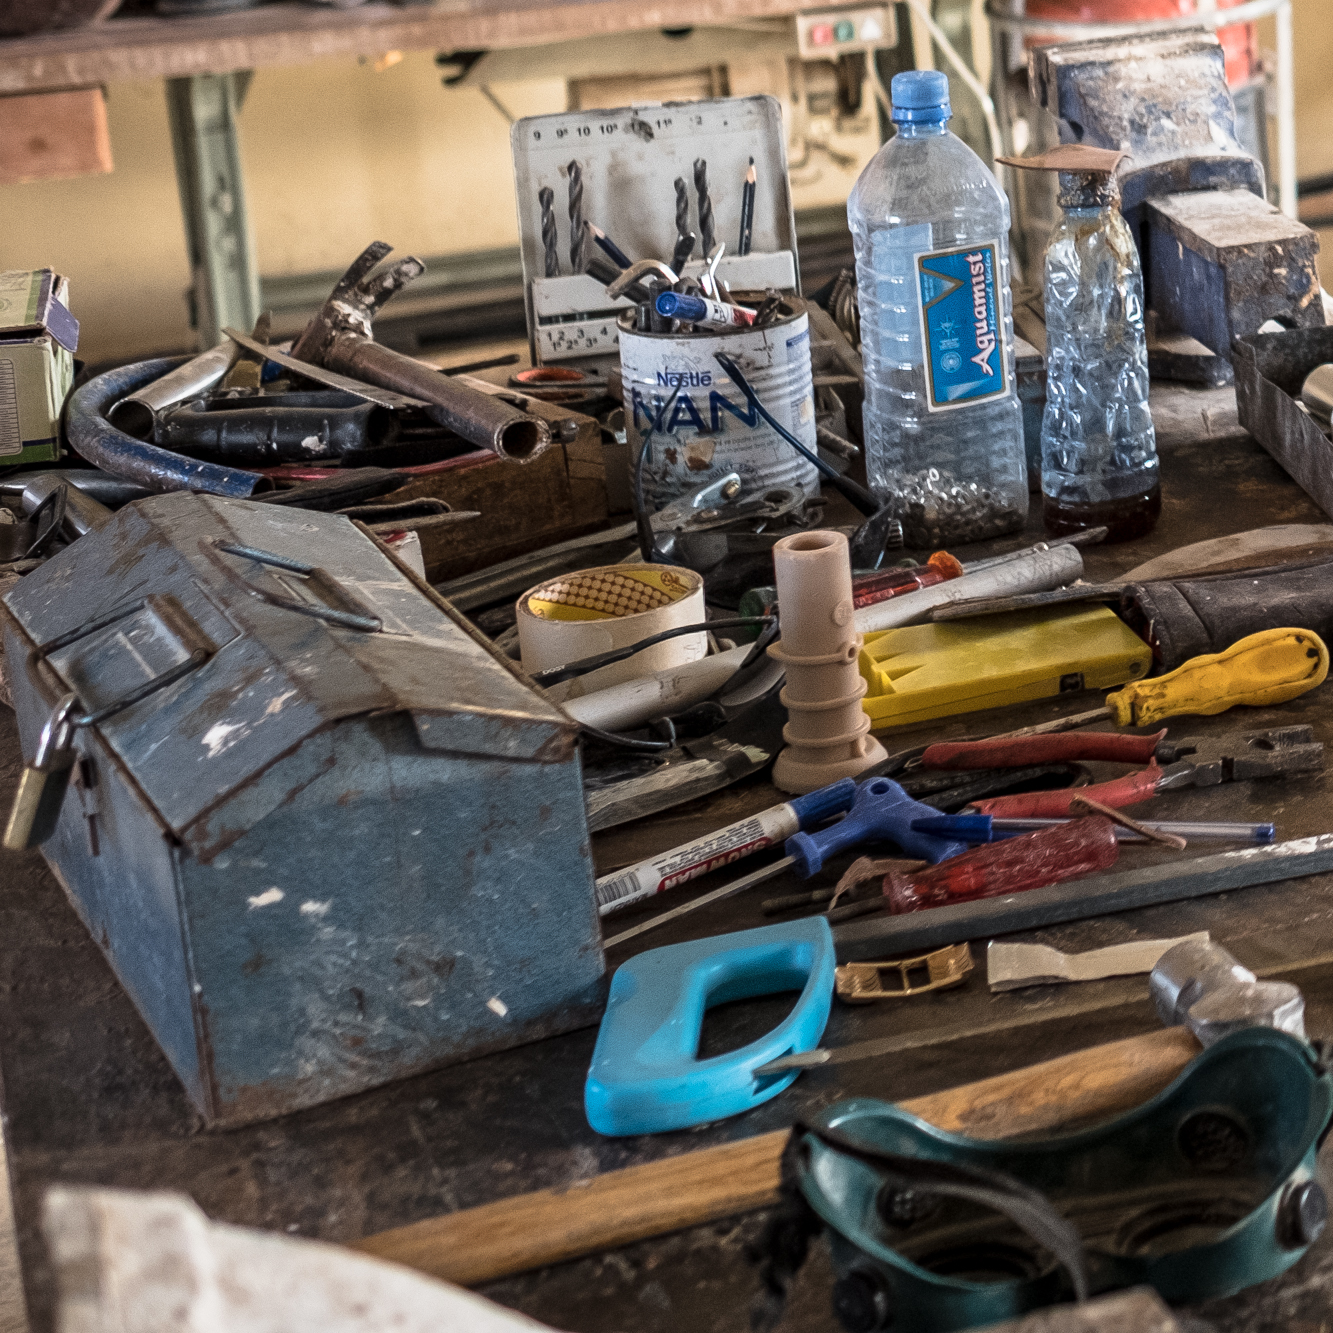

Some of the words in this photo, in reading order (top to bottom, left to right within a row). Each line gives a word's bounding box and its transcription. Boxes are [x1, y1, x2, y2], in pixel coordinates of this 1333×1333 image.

[577, 125, 591, 137] 10
[984, 251, 995, 284] Water
[964, 250, 996, 378] Aquamist
[986, 285, 997, 331] Mineral
[631, 386, 760, 435] NAN
